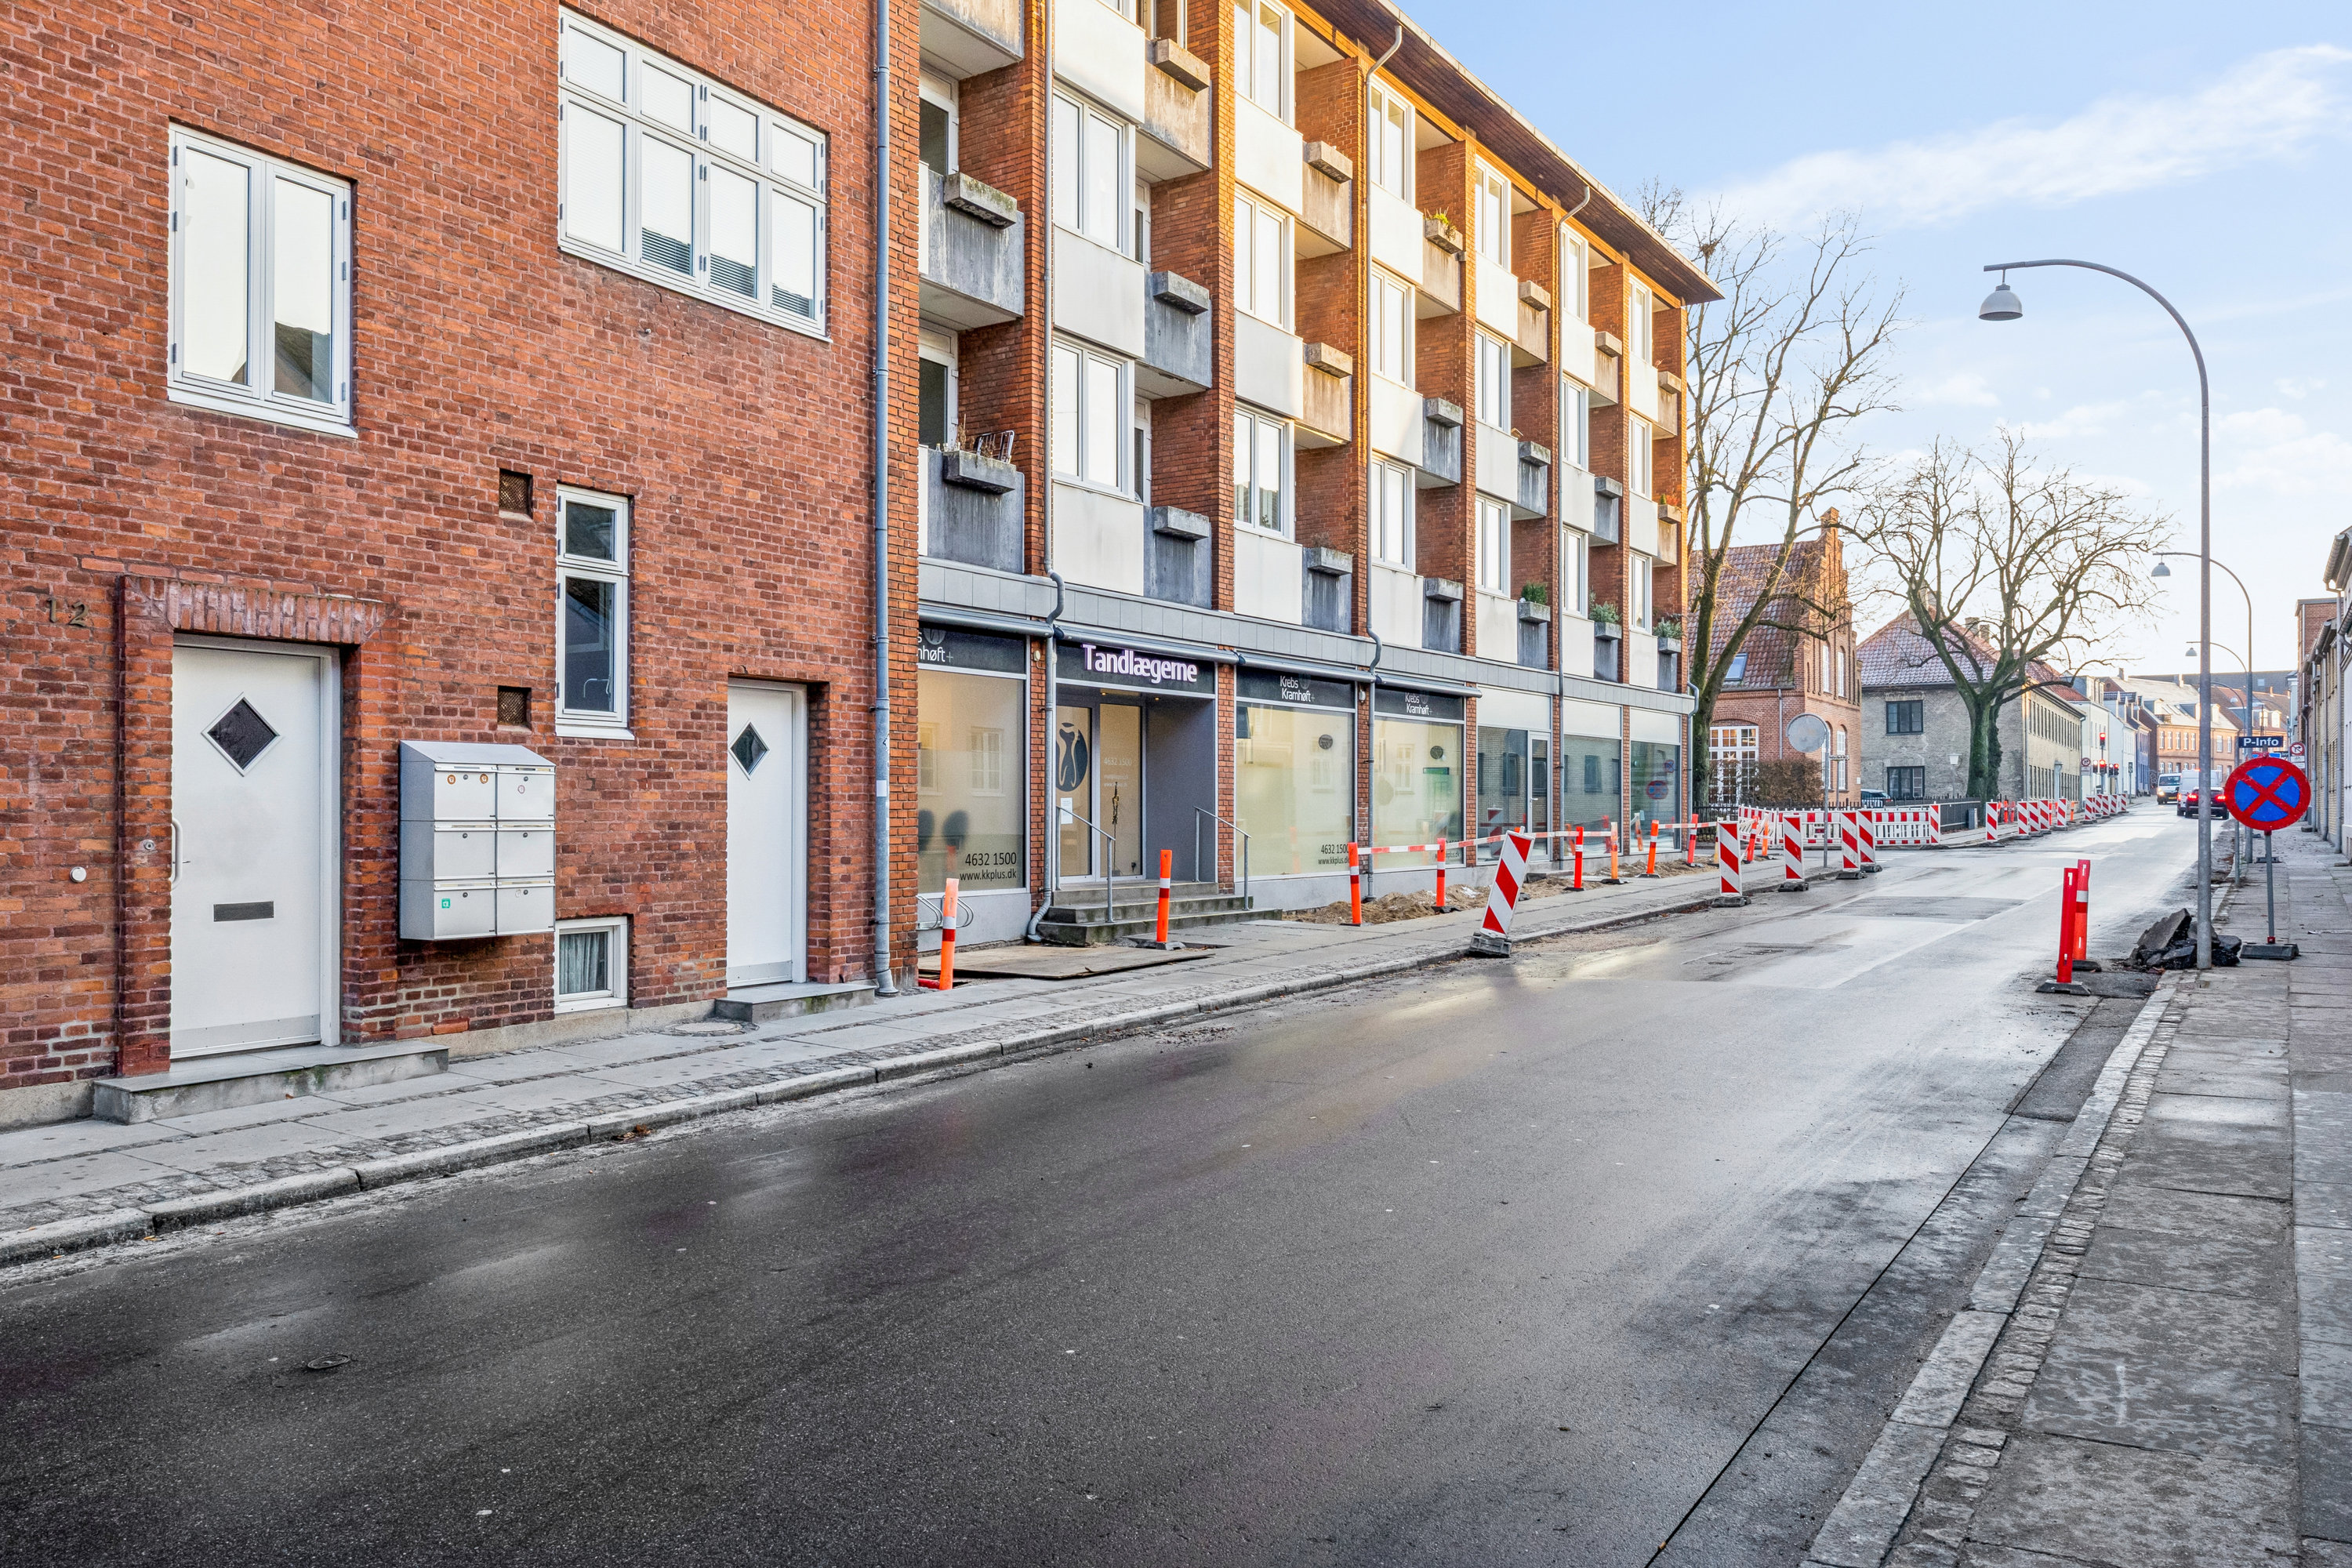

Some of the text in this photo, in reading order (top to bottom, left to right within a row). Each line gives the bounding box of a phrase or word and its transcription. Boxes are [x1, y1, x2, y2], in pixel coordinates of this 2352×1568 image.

[47, 597, 89, 627] 12
[1081, 643, 1198, 684] Tandlægerne
[1279, 675, 1298, 688] Krebs
[1405, 692, 1419, 703] Krebs
[2243, 737, 2279, 746] P-Info
[1321, 844, 1334, 855] 4632
[965, 851, 1017, 866] 4632 1500
[960, 868, 1017, 881] www.kkplus.dk
